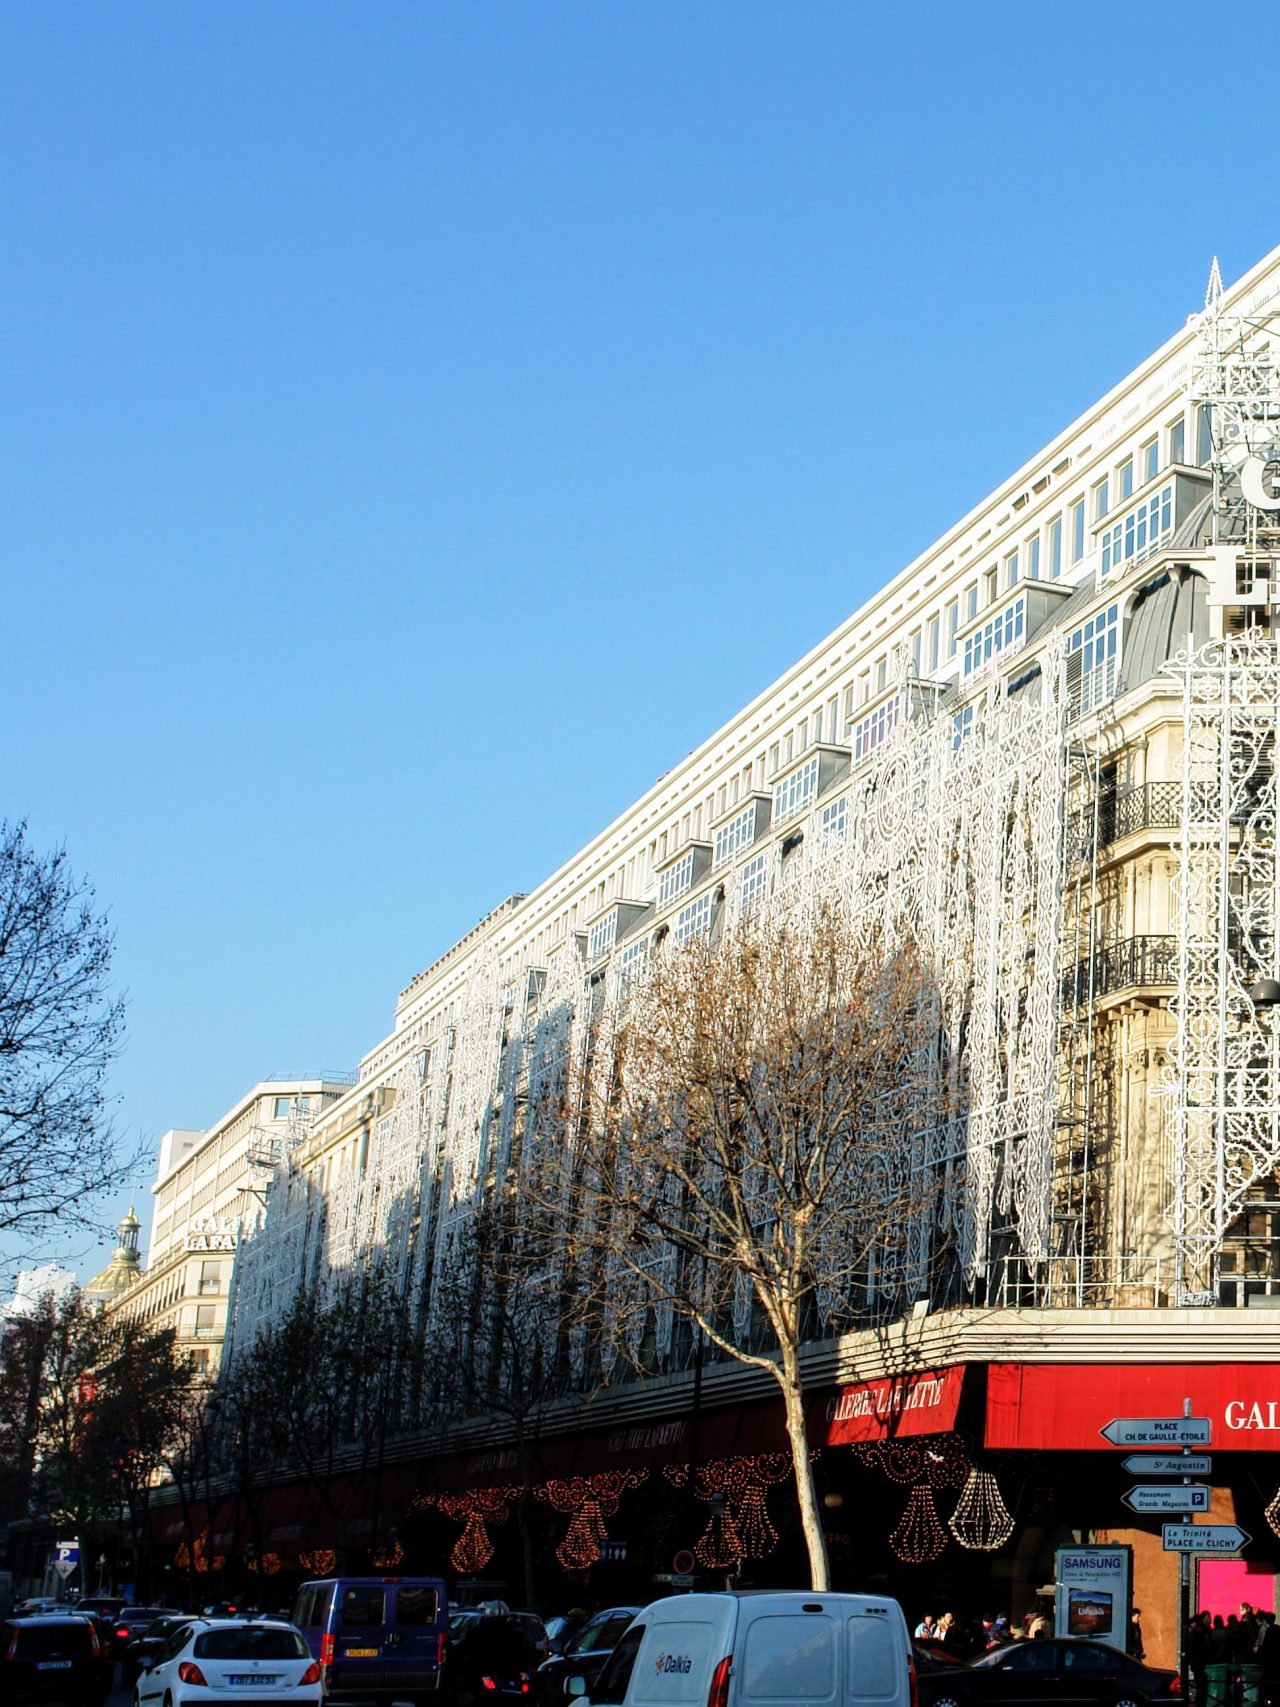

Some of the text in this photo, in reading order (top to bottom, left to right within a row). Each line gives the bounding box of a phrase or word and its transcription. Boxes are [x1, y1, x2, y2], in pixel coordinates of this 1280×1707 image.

[826, 1389, 878, 1422] GALERIES
[1154, 1423, 1178, 1431] PLACE
[1125, 1433, 1136, 1441] CH.
[1138, 1433, 1148, 1441] DE
[1166, 1461, 1206, 1470] Augustin
[1194, 1494, 1202, 1504] P
[1162, 1501, 1189, 1509] Magasins
[1183, 1529, 1212, 1537] Trinité
[1206, 1540, 1236, 1548] CLICHY
[58, 1548, 71, 1561] P
[1064, 1558, 1121, 1569] SAMSUNG
[664, 1655, 692, 1674] Dalkia
